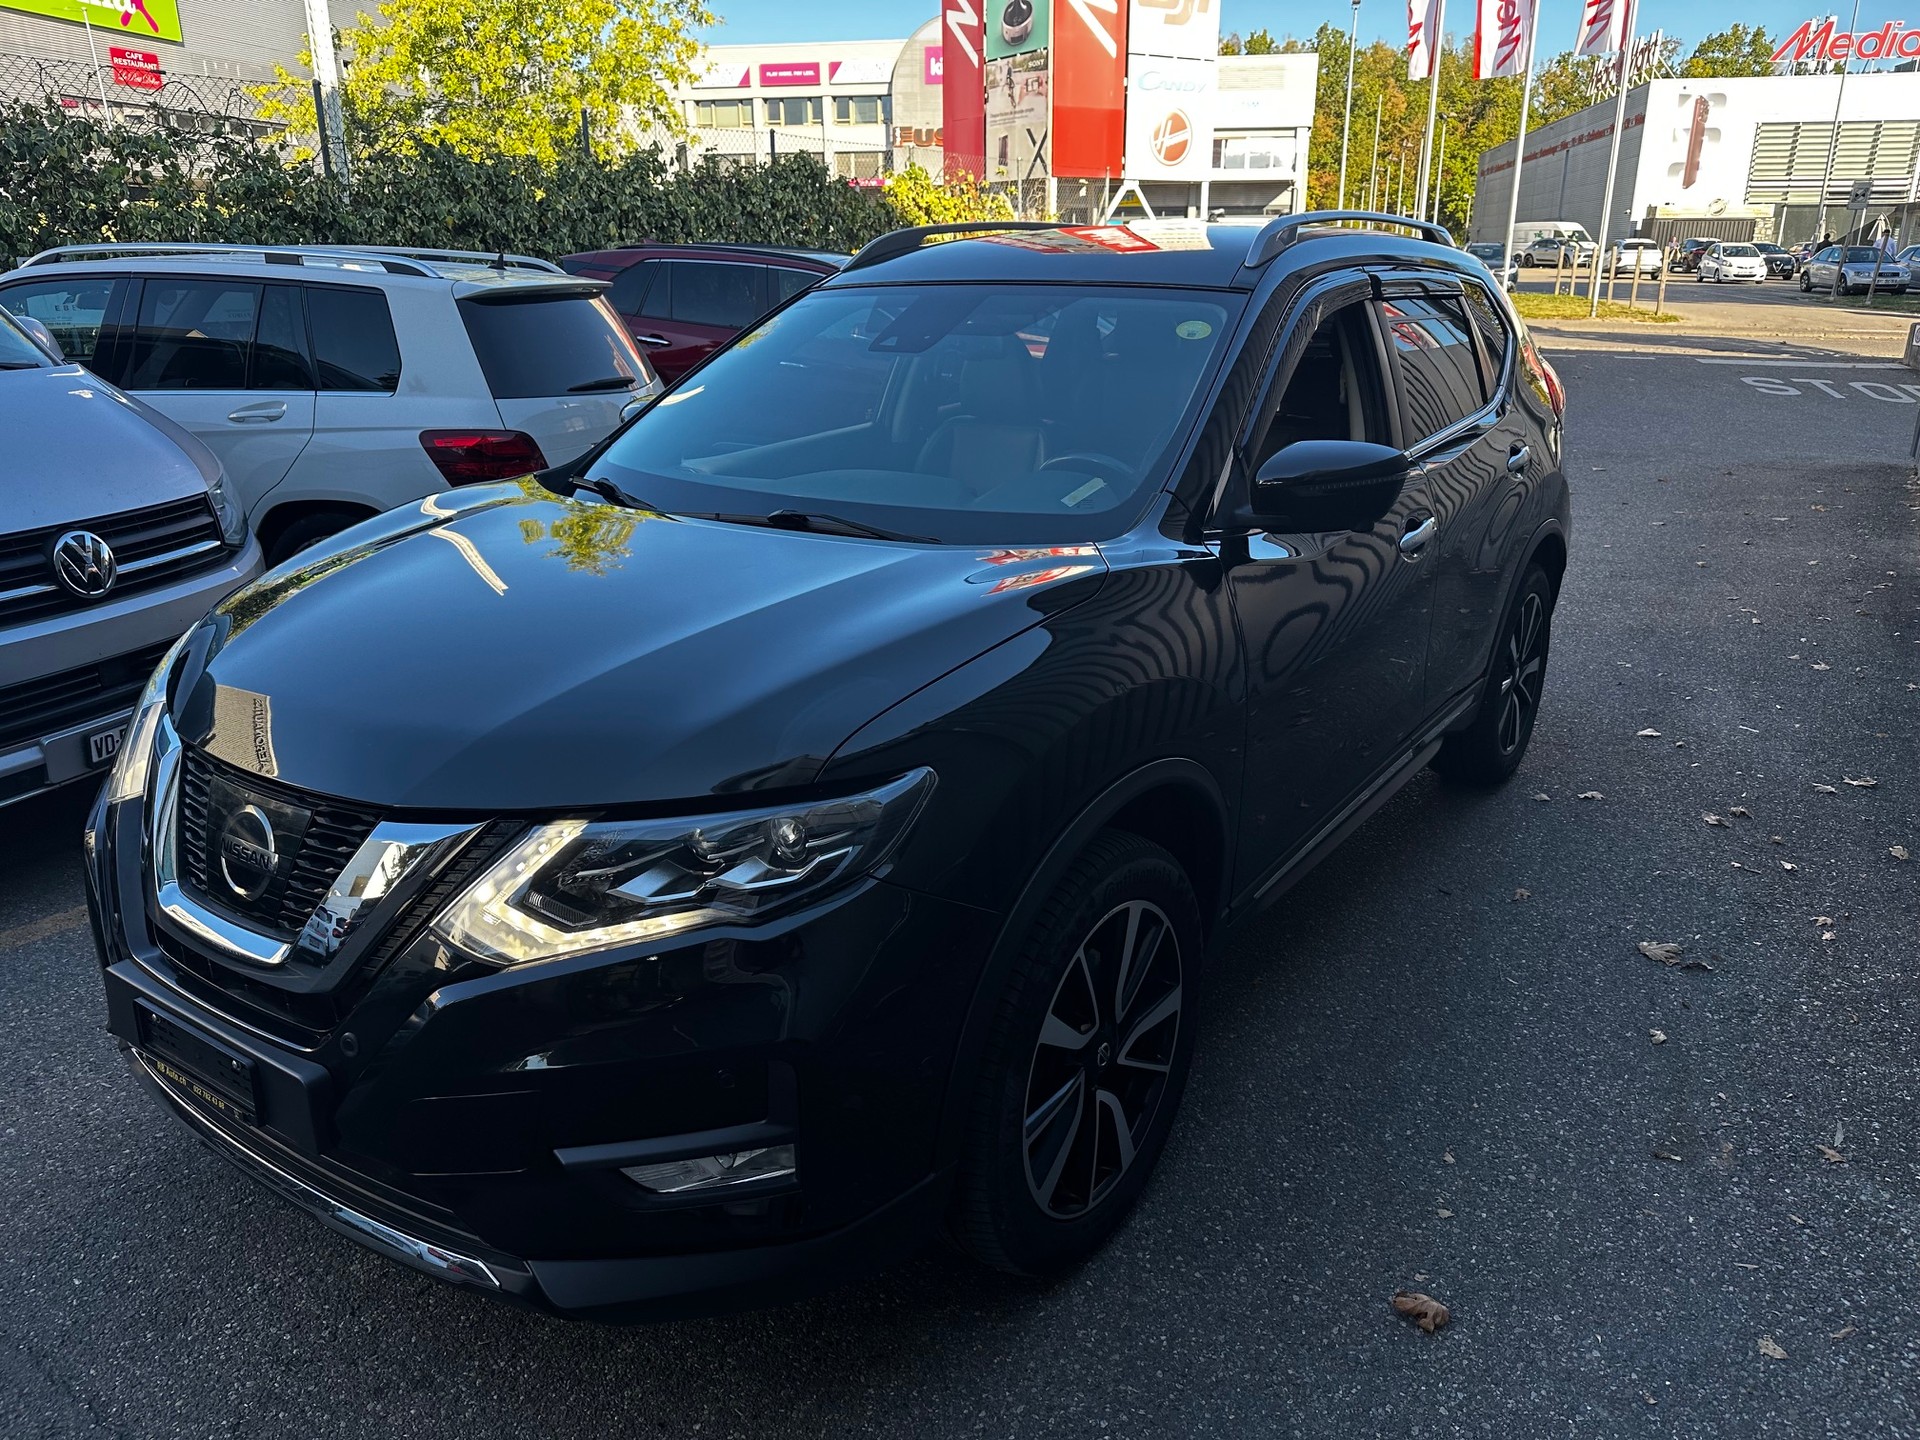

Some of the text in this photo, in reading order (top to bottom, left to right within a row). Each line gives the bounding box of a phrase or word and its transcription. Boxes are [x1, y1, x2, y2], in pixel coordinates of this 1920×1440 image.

[125, 51, 144, 61] CAFE
[113, 57, 158, 70] RESTAURANT
[1028, 59, 1045, 68] SONY
[221, 839, 272, 871] NISSAN
